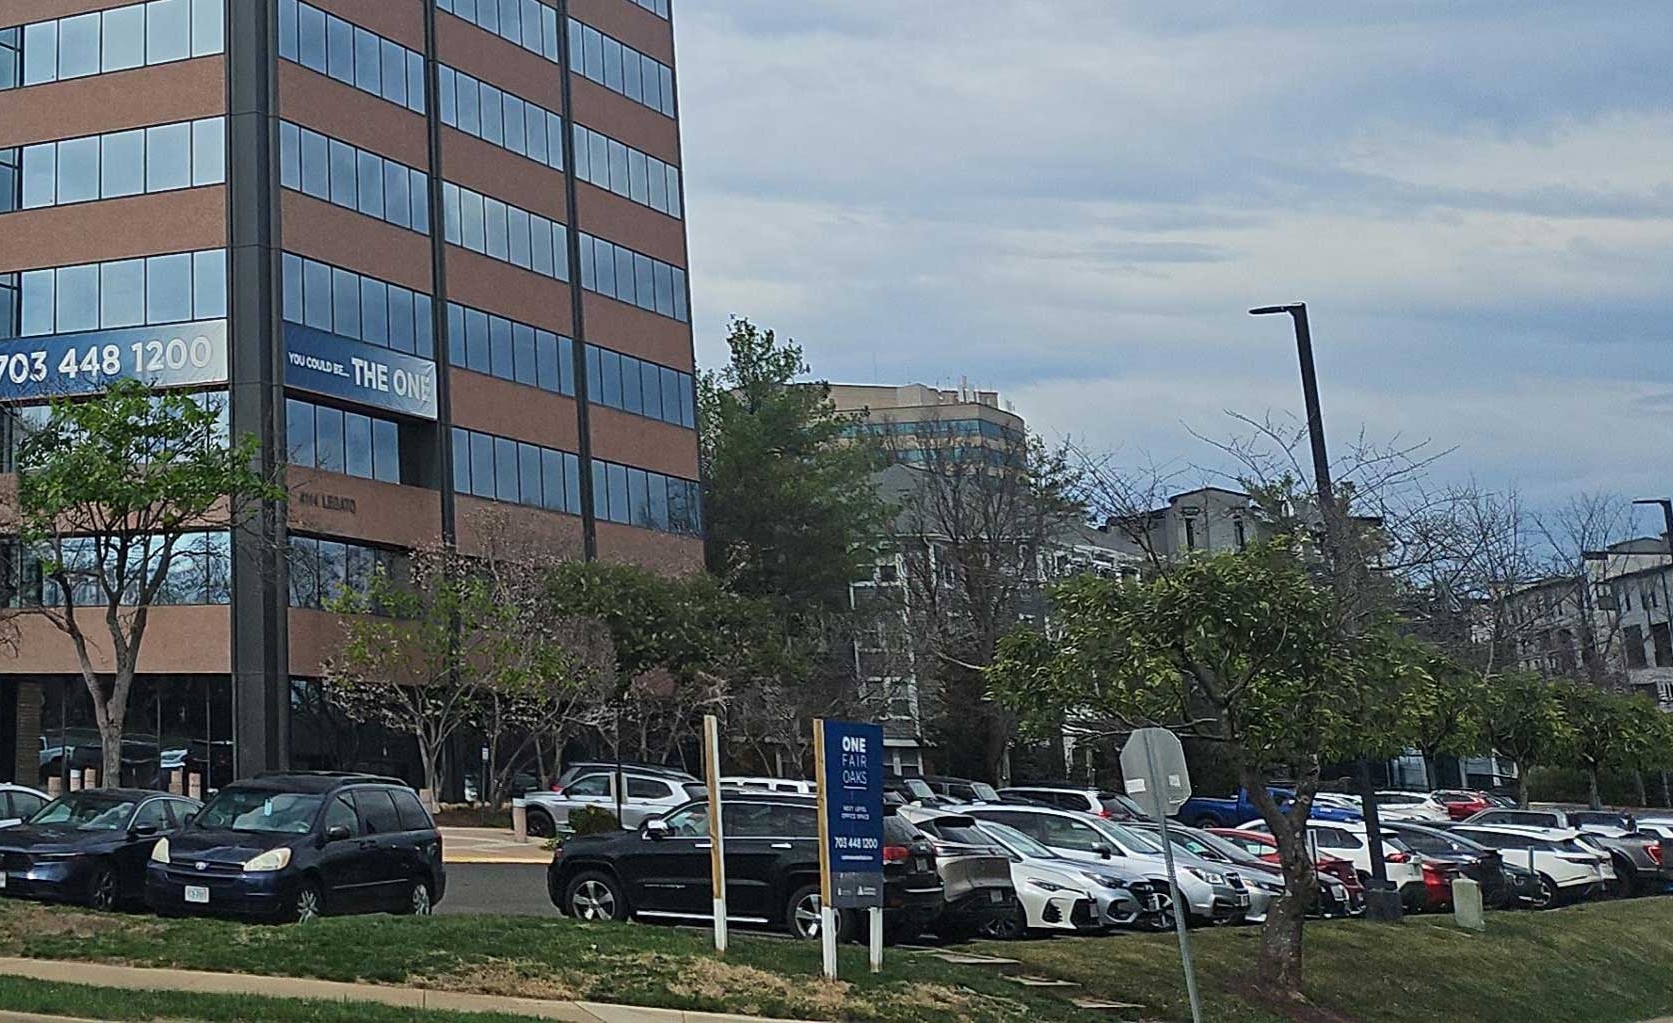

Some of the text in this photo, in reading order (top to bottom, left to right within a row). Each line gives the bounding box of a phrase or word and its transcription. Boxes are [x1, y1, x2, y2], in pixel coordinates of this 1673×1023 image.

[58, 344, 121, 379] 448
[131, 336, 212, 373] 1200
[288, 351, 306, 367] YOU
[306, 356, 333, 373] COULD
[351, 357, 389, 392] THE
[393, 368, 431, 402] ONE
[842, 736, 867, 753] ONE
[842, 753, 867, 768] FAIR
[842, 769, 868, 785] OAKS
[834, 836, 879, 849] 703 448 1200
